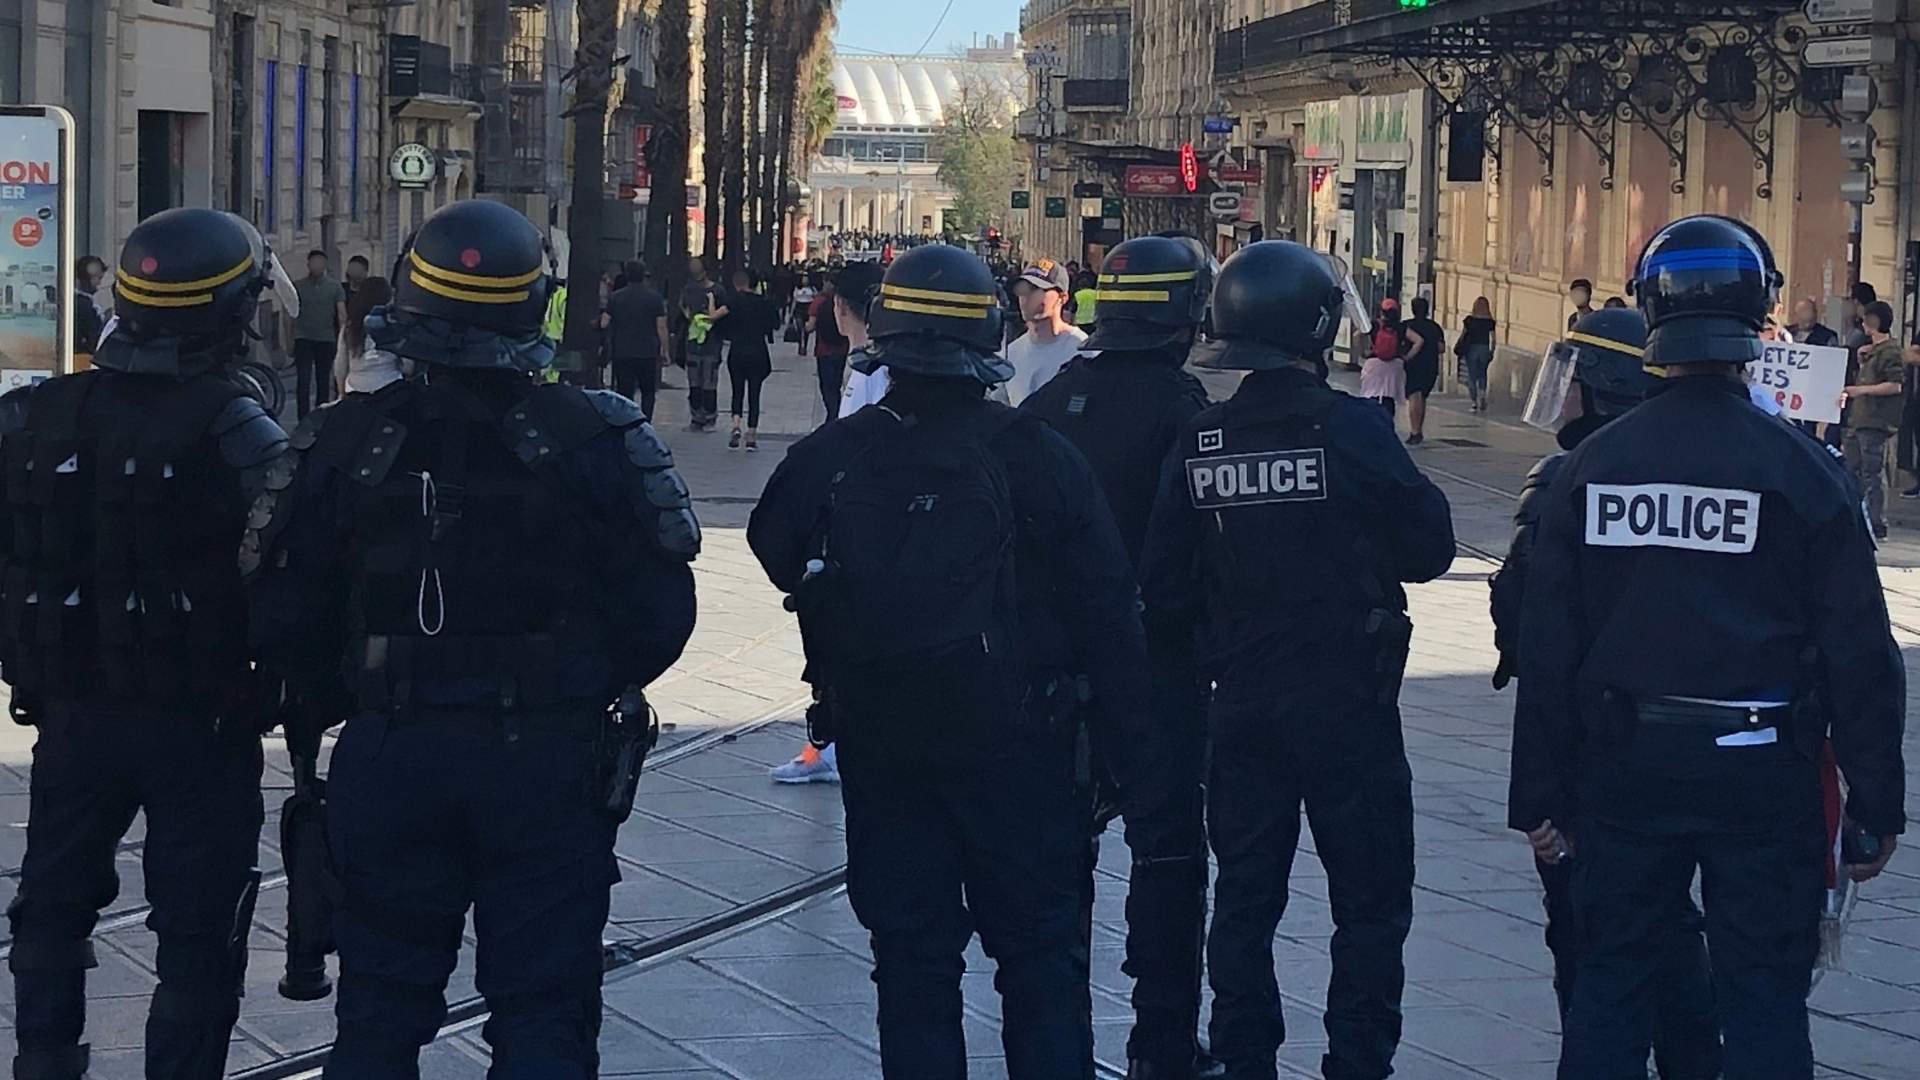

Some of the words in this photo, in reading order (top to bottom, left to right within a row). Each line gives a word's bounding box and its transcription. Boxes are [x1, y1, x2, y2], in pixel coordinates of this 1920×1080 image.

[0, 161, 50, 183] ON
[1760, 347, 1810, 369] ETEZ
[1193, 458, 1318, 498] POLICE
[1597, 493, 1748, 544] POLICE
